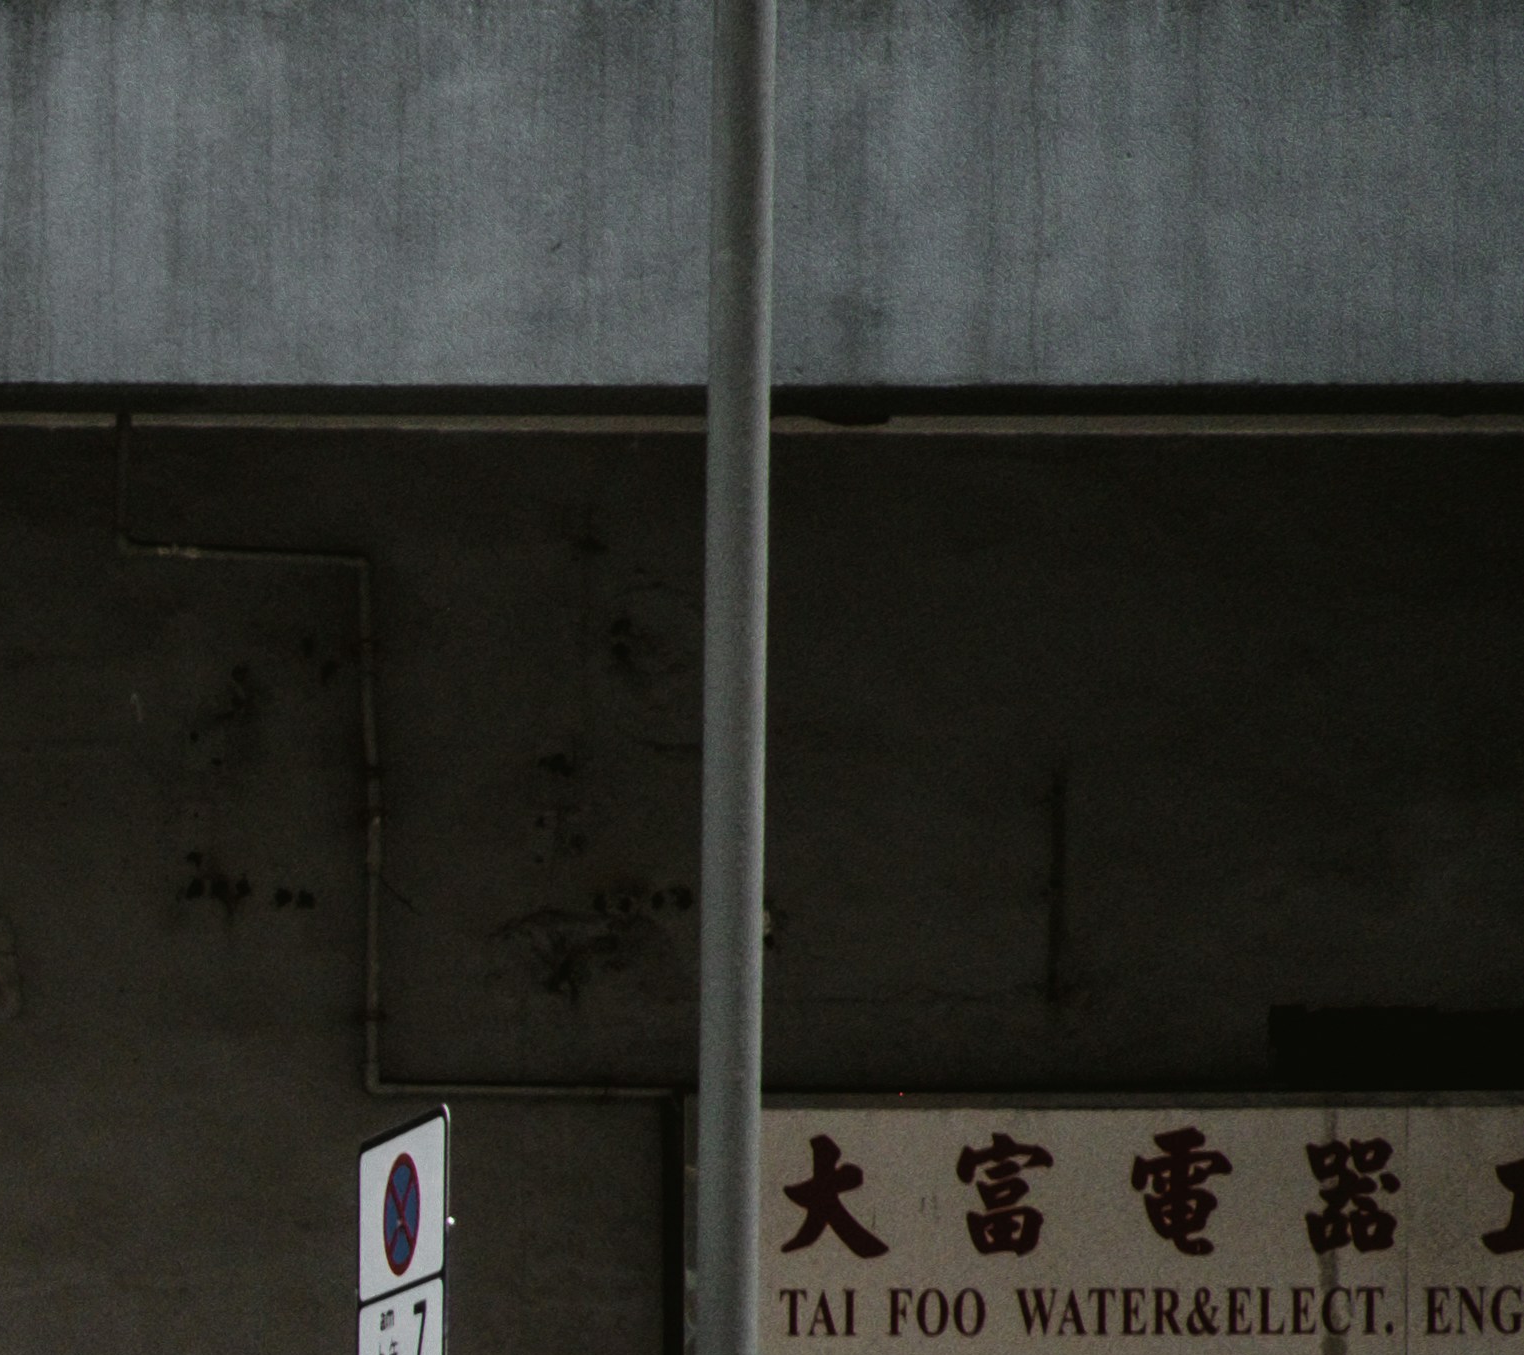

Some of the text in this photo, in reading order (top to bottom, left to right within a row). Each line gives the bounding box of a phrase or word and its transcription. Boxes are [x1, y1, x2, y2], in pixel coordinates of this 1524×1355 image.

[379, 1309, 395, 1331] am
[779, 1287, 856, 1339] TAI
[888, 1287, 987, 1339] FOO
